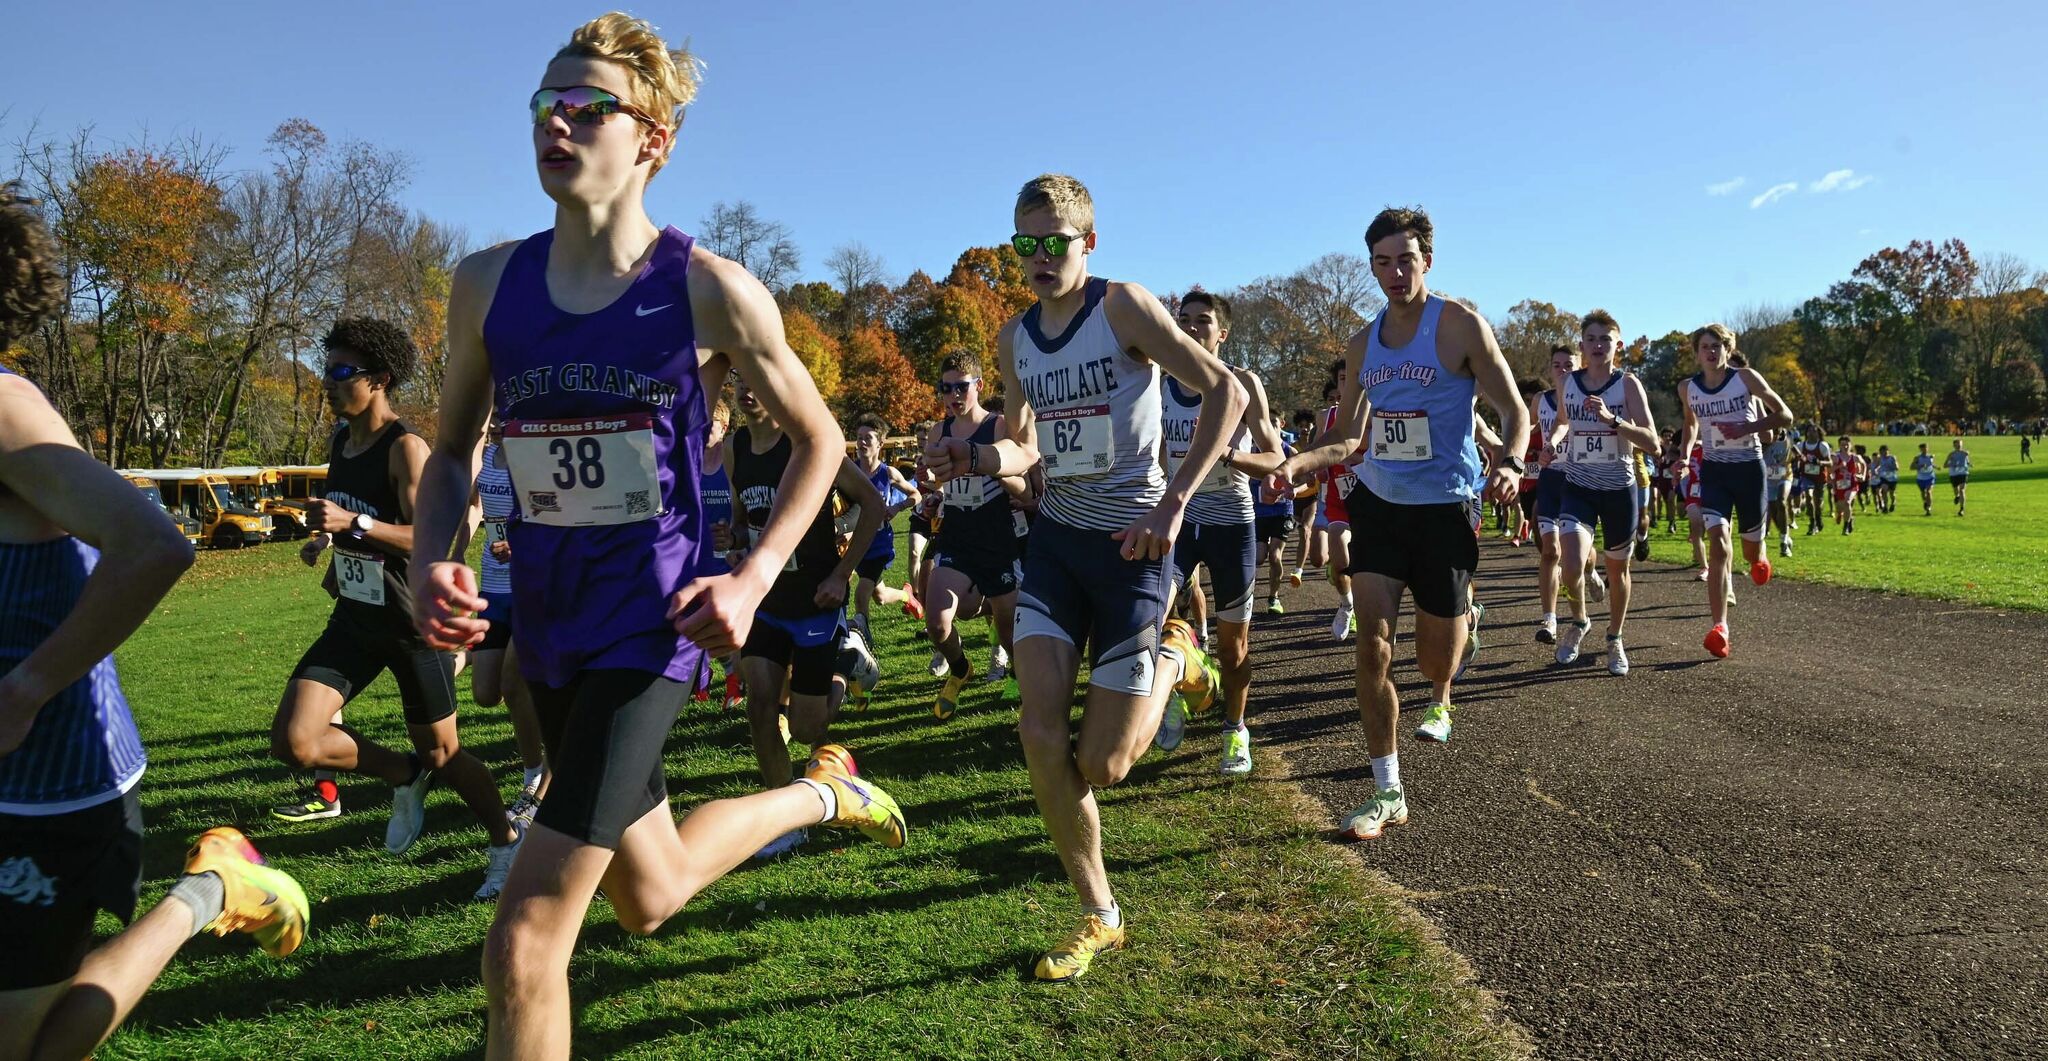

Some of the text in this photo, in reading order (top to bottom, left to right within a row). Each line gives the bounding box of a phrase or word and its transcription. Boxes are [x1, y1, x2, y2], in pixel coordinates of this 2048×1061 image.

[559, 363, 677, 409] GRANBY
[1361, 361, 1436, 388] Hale-Ray
[521, 419, 627, 433] CIAC Class S Boys
[1054, 419, 1082, 453] 62
[1384, 420, 1407, 443] 50
[1556, 440, 1569, 454] 67
[1586, 437, 1603, 452] 64
[549, 436, 605, 490] 38
[343, 557, 365, 583] 33
